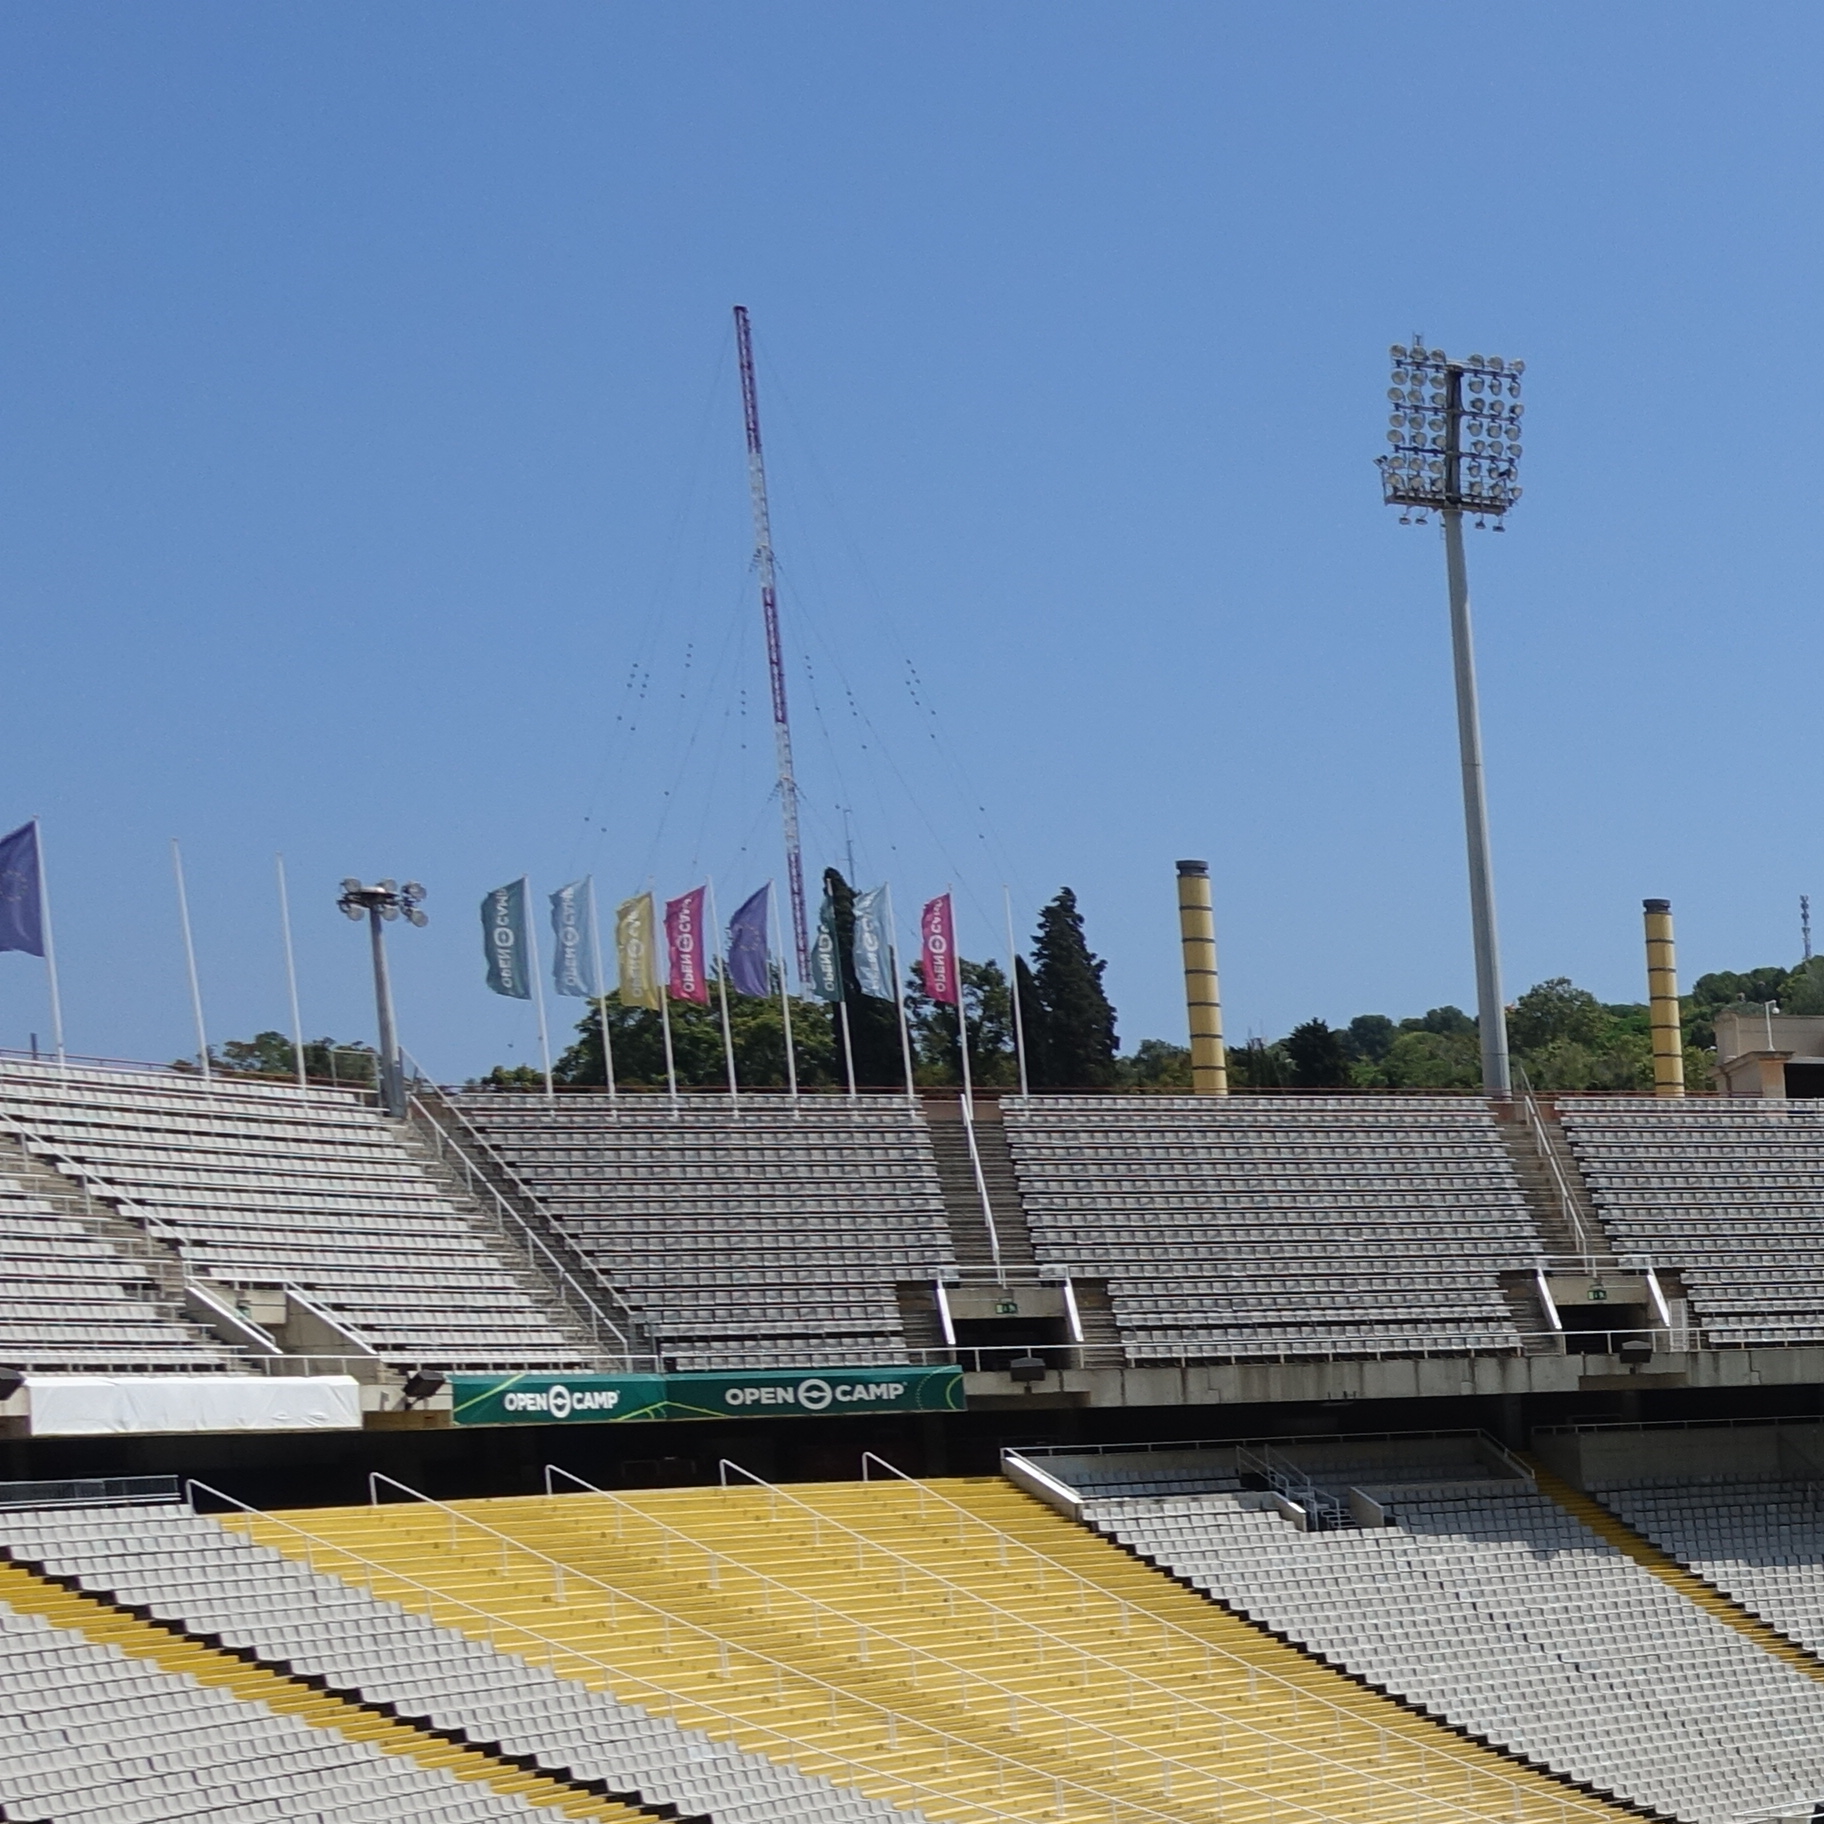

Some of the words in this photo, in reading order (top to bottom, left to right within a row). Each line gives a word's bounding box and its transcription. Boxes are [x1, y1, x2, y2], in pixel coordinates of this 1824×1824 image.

[504, 1392, 549, 1412] OPEN
[572, 1390, 618, 1410] CAMP
[725, 1385, 795, 1406] OPEN
[834, 1383, 905, 1402] CAMP
